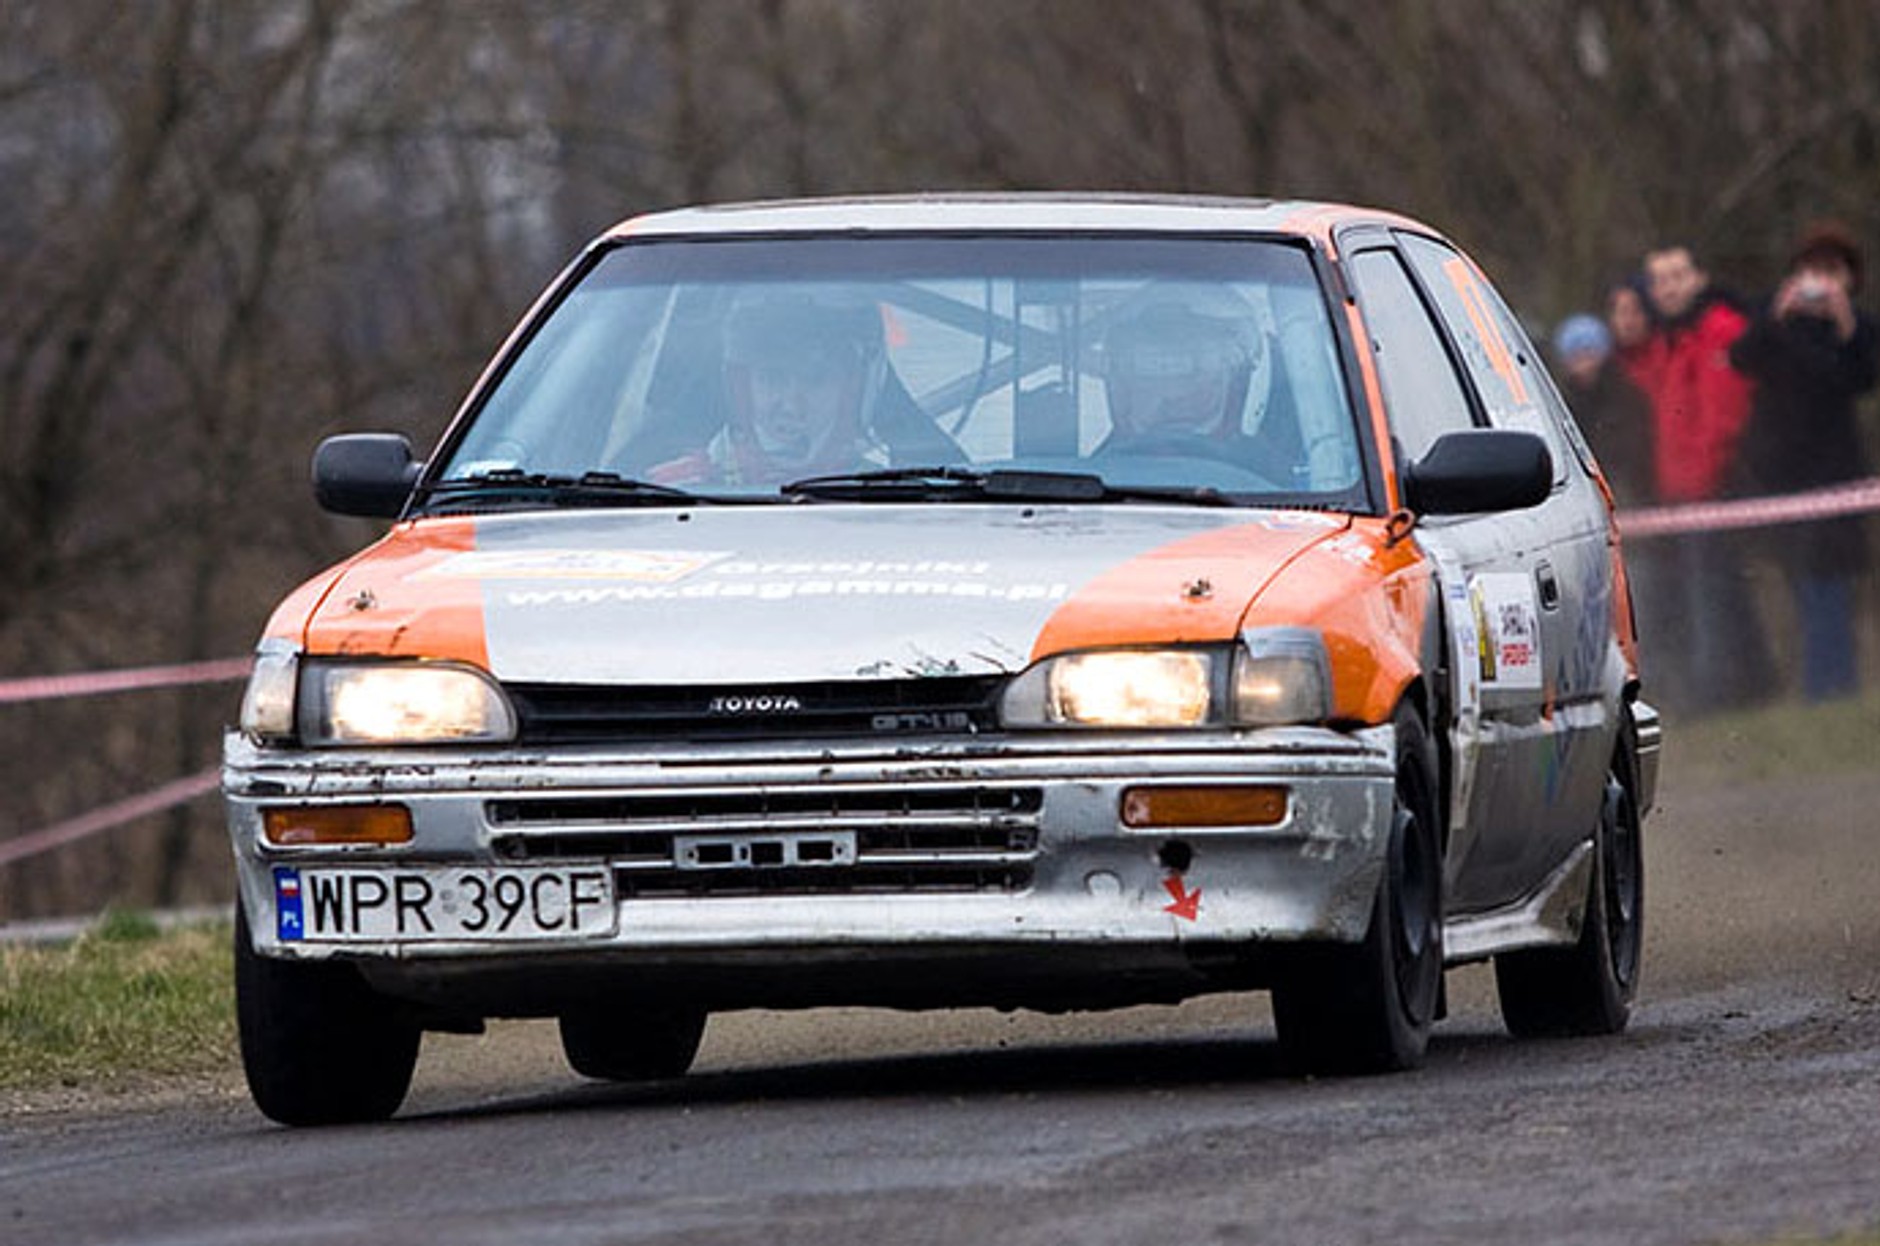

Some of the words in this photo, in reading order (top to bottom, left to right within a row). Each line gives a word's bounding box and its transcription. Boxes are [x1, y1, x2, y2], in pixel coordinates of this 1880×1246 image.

[505, 580, 1072, 605] www.dagamma.pl
[713, 695, 801, 711] TOYOTA
[309, 875, 434, 933] WPR
[459, 872, 605, 932] 39CF
